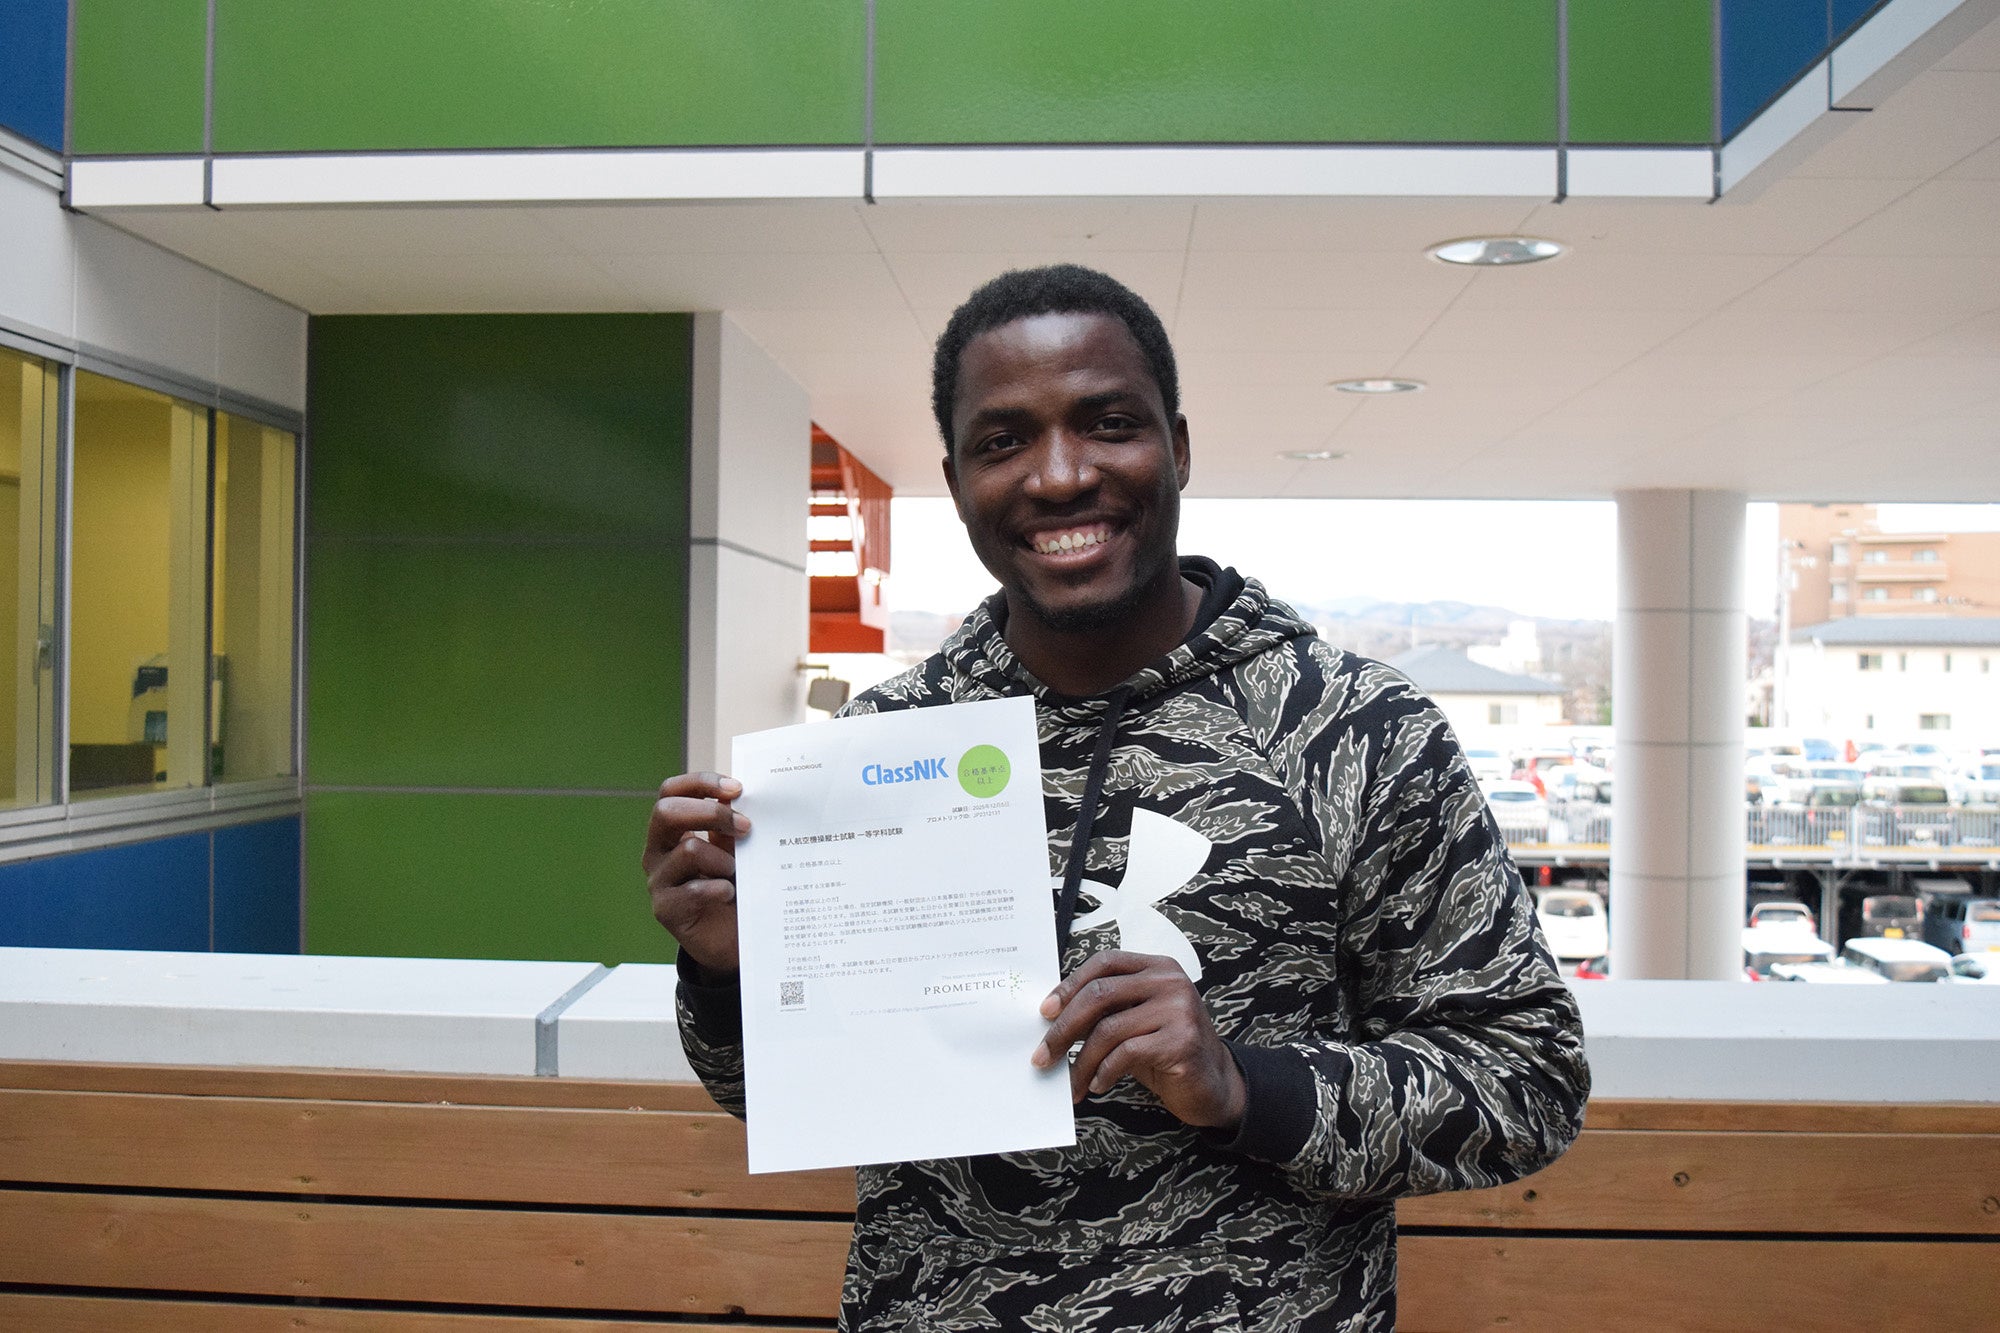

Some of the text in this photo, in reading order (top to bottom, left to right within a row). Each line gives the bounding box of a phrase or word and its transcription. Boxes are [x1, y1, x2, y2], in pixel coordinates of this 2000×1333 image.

[862, 757, 949, 786] ClassNK
[977, 777, 993, 785] 以上
[779, 827, 903, 847] 無人航空機操縦士試験 一等学科試験
[924, 979, 1006, 996] PROMETRIC
